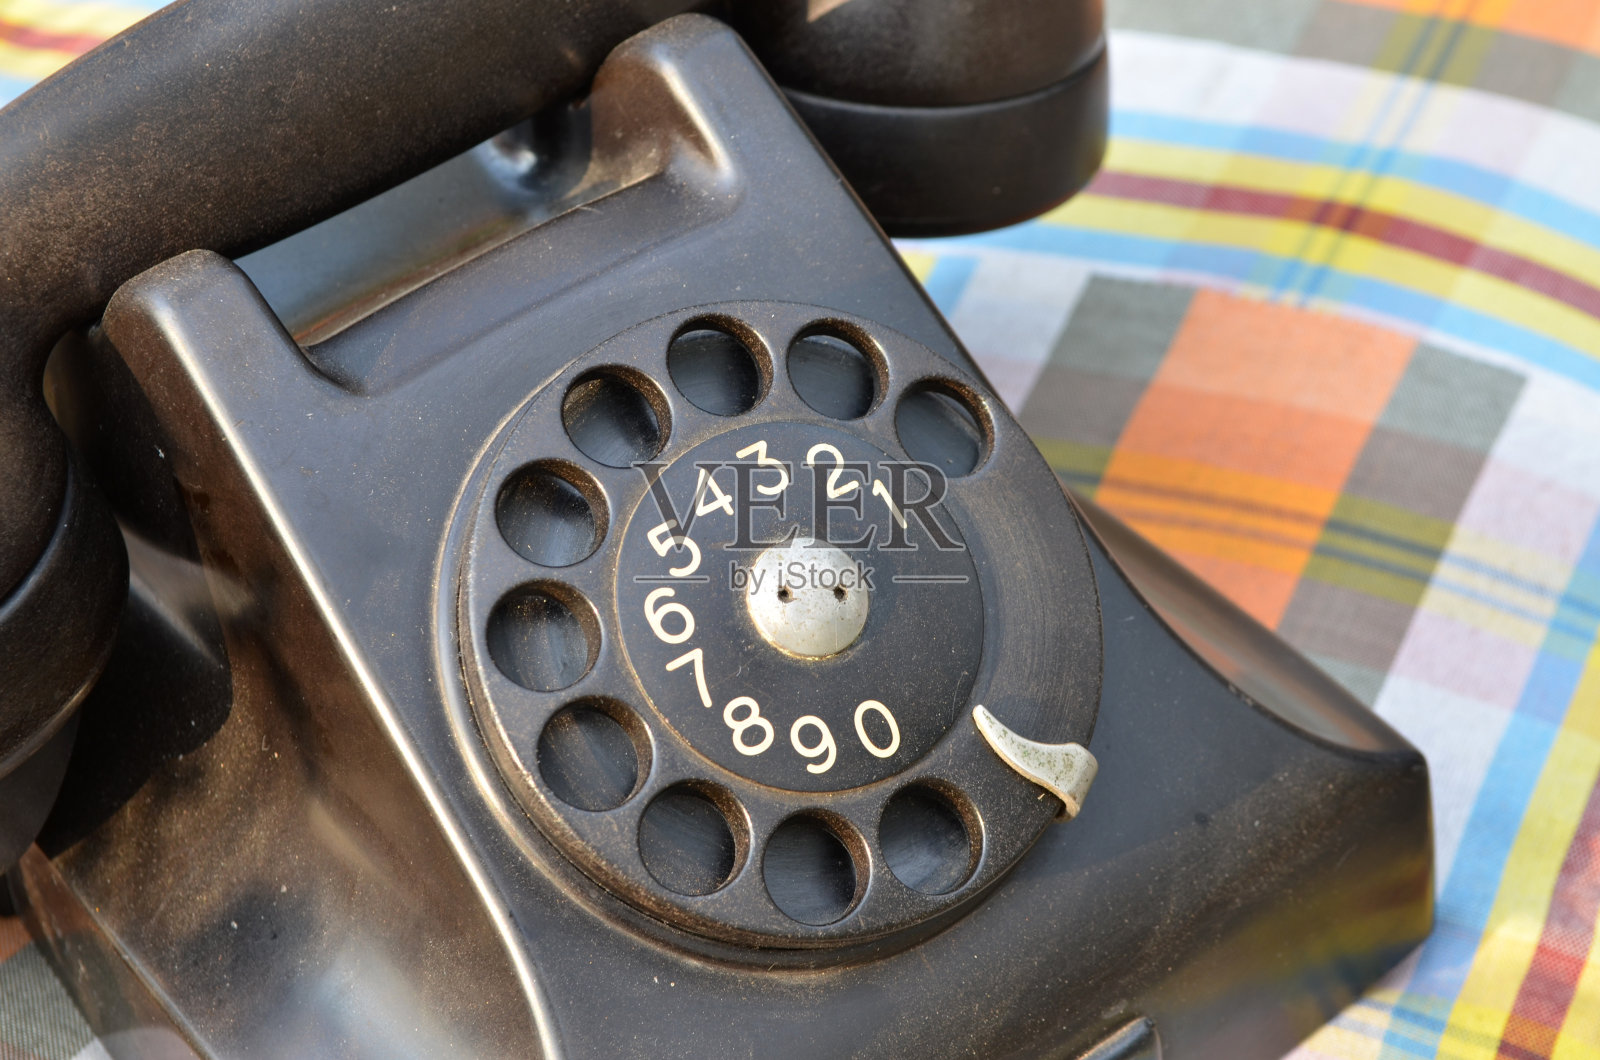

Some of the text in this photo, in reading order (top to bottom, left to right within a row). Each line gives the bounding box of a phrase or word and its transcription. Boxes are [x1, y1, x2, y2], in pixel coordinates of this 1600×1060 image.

[695, 467, 734, 517] 4
[736, 440, 789, 495] 3
[807, 443, 860, 499] 2
[872, 479, 908, 529] 1
[647, 519, 701, 577] 5
[644, 587, 695, 644] 6
[665, 648, 712, 708] 7
[723, 696, 775, 756] 8
[790, 715, 837, 774] 9
[854, 700, 900, 758] 0
